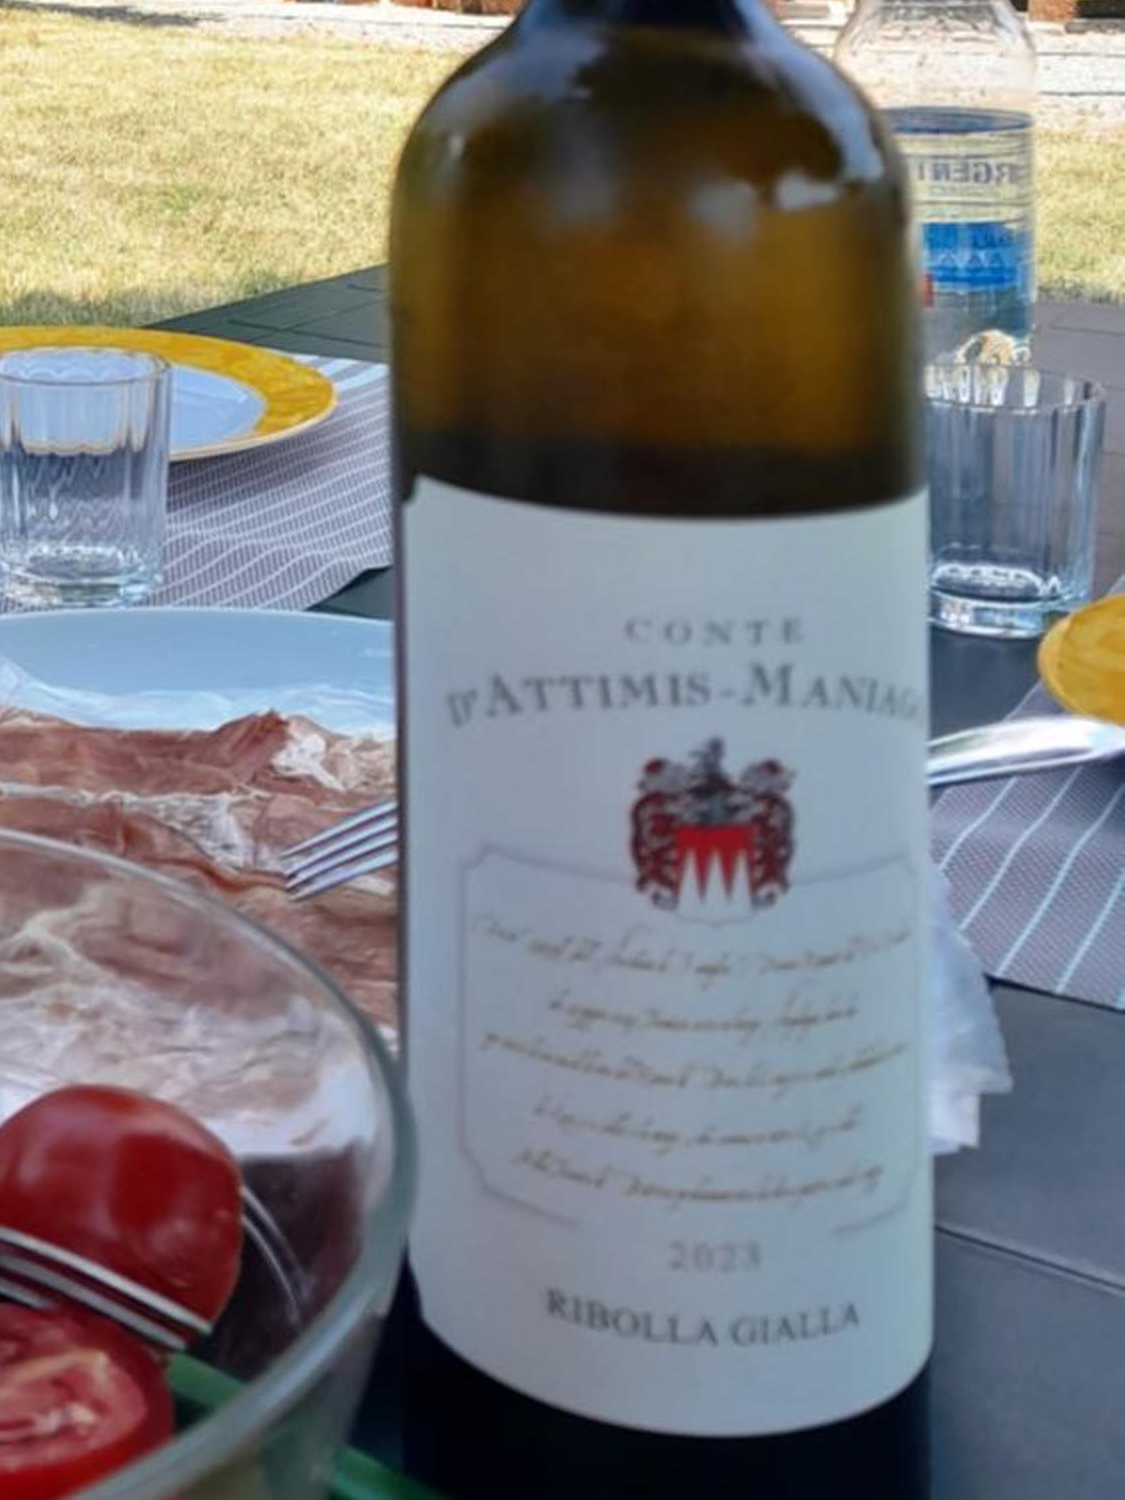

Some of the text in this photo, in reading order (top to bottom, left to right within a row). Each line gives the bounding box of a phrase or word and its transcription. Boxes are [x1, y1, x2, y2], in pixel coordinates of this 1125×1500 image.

[624, 616, 806, 647] CONTE
[667, 1241, 764, 1273] 2023
[545, 1288, 860, 1347] RIBOLLA GIALLA
